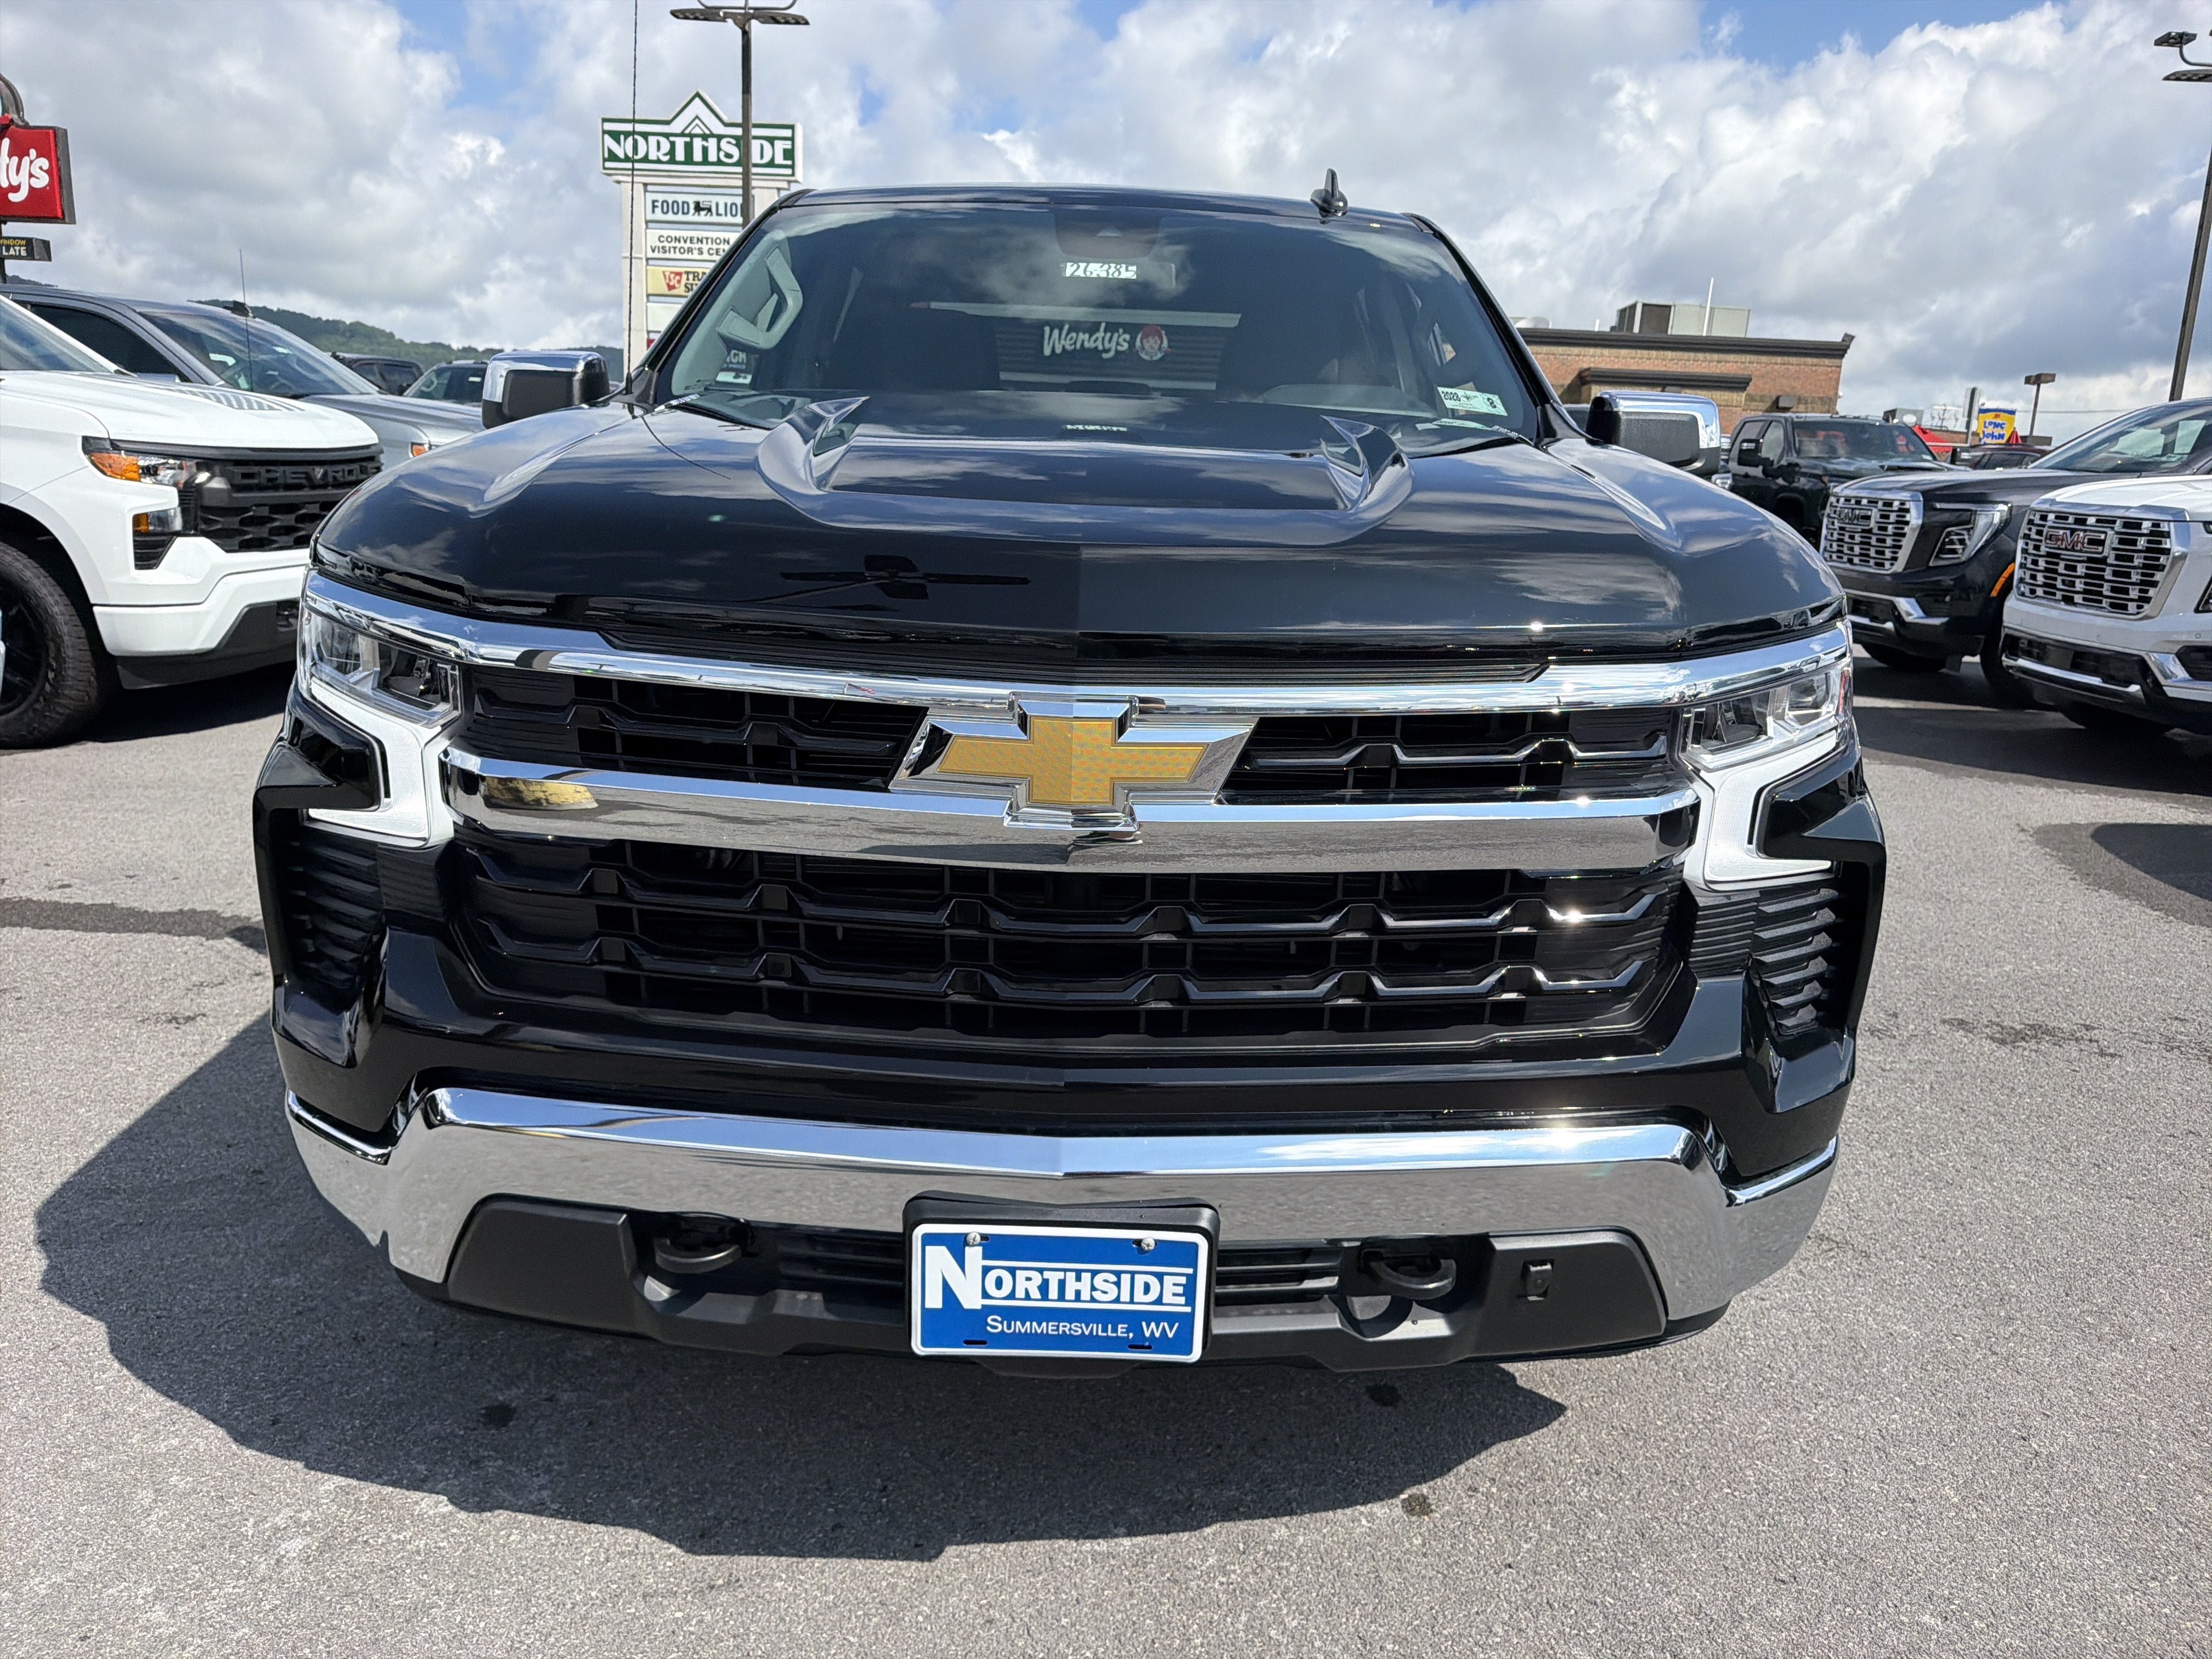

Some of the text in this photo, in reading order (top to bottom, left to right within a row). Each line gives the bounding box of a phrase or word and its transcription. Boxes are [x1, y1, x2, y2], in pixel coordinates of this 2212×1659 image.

[604, 134, 792, 164] NORTHSDE
[652, 199, 743, 217] FOOD LIO
[658, 235, 730, 245] CONVENTION
[3, 246, 27, 256] LATE
[650, 245, 703, 255] VISITOR'S
[1043, 322, 1130, 359] Wendy's
[1487, 397, 1497, 409] 8
[2044, 530, 2106, 552] GMC
[924, 1245, 1187, 1310] NORTHSIDE
[1141, 1322, 1179, 1339] WV
